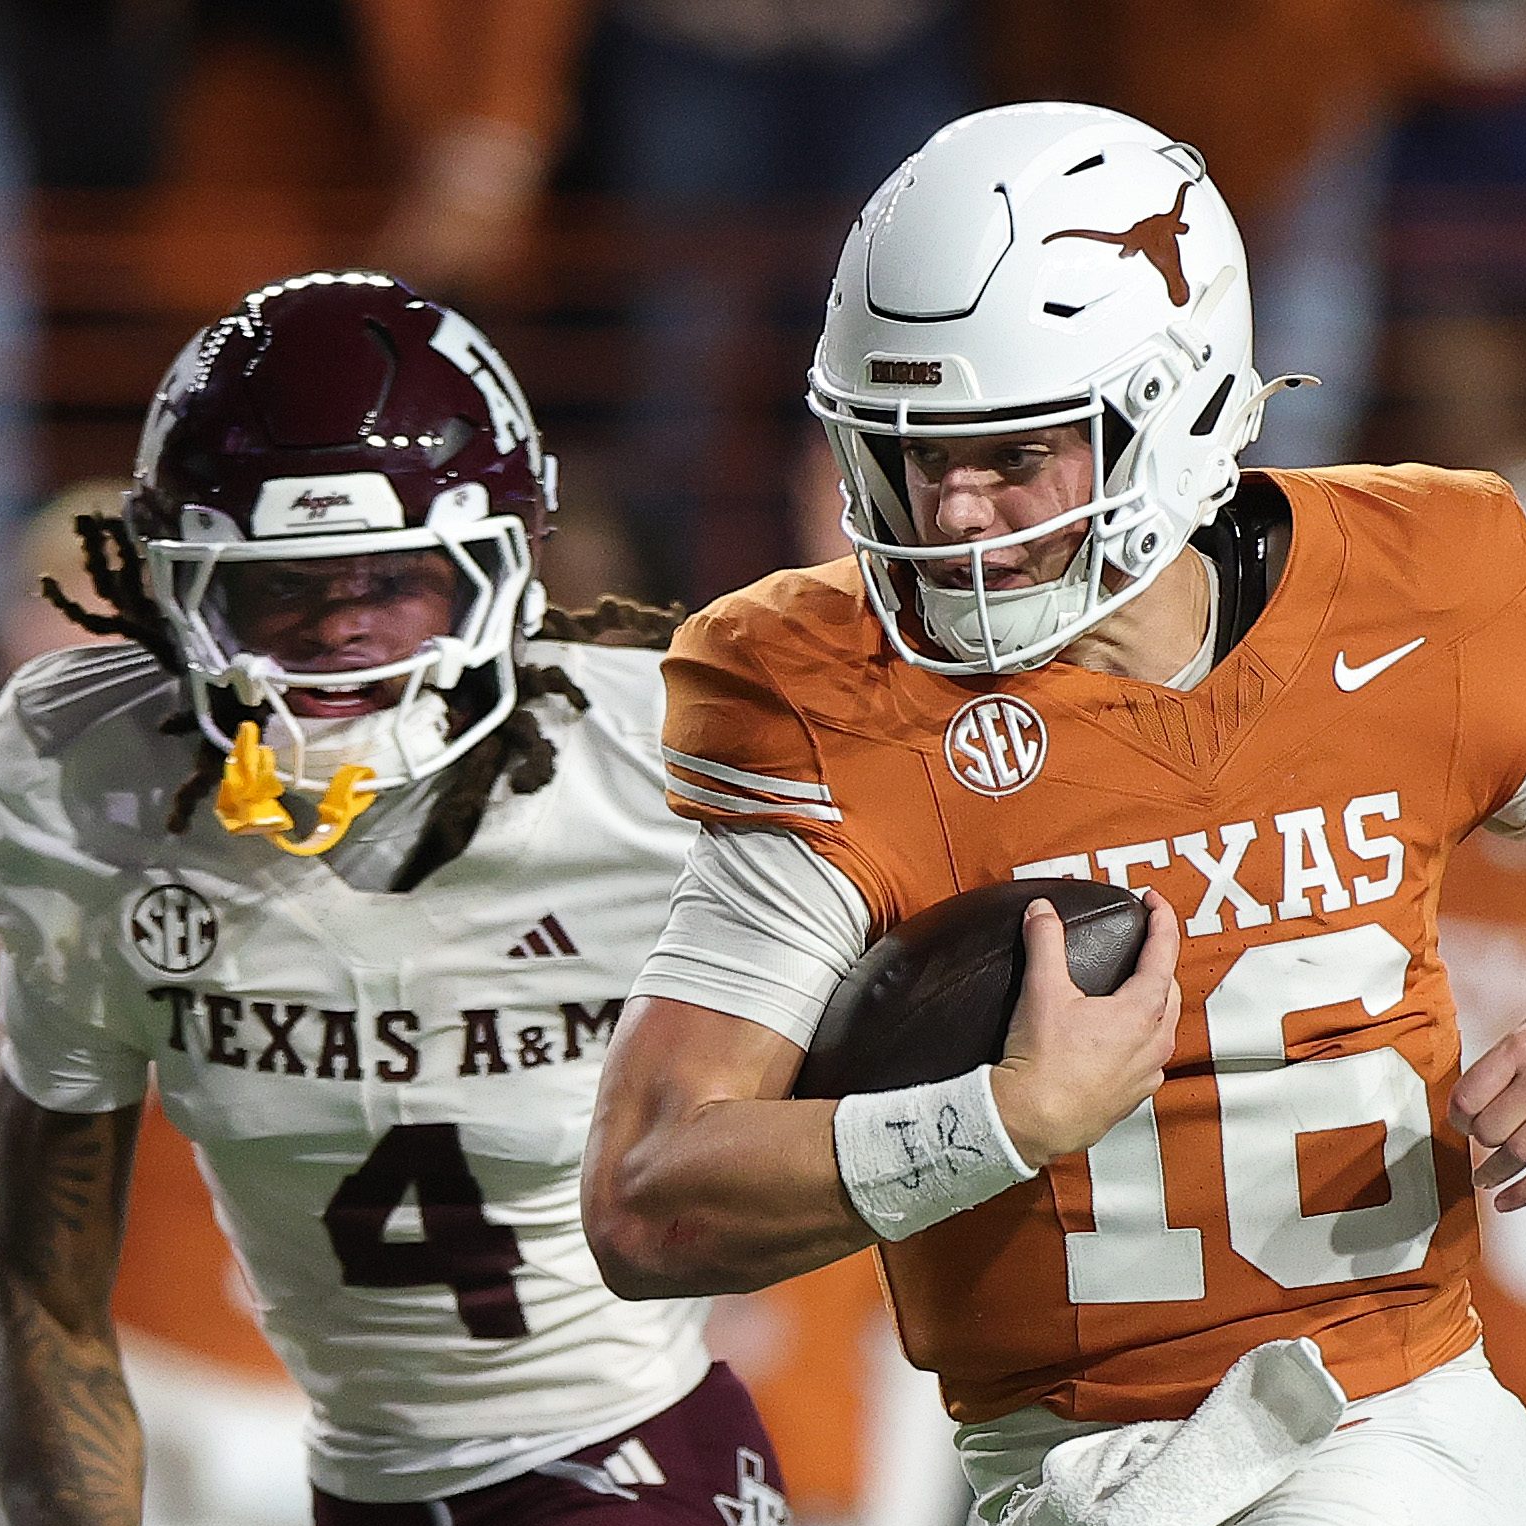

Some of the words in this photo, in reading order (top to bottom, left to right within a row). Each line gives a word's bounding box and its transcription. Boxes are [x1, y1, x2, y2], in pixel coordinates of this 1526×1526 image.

[953, 701, 1039, 789] SEC
[133, 888, 215, 970] SEC
[146, 986, 420, 1083] TEXAS
[459, 999, 622, 1078] A&M
[1065, 923, 1442, 1304] 16
[321, 1123, 529, 1338] 4
